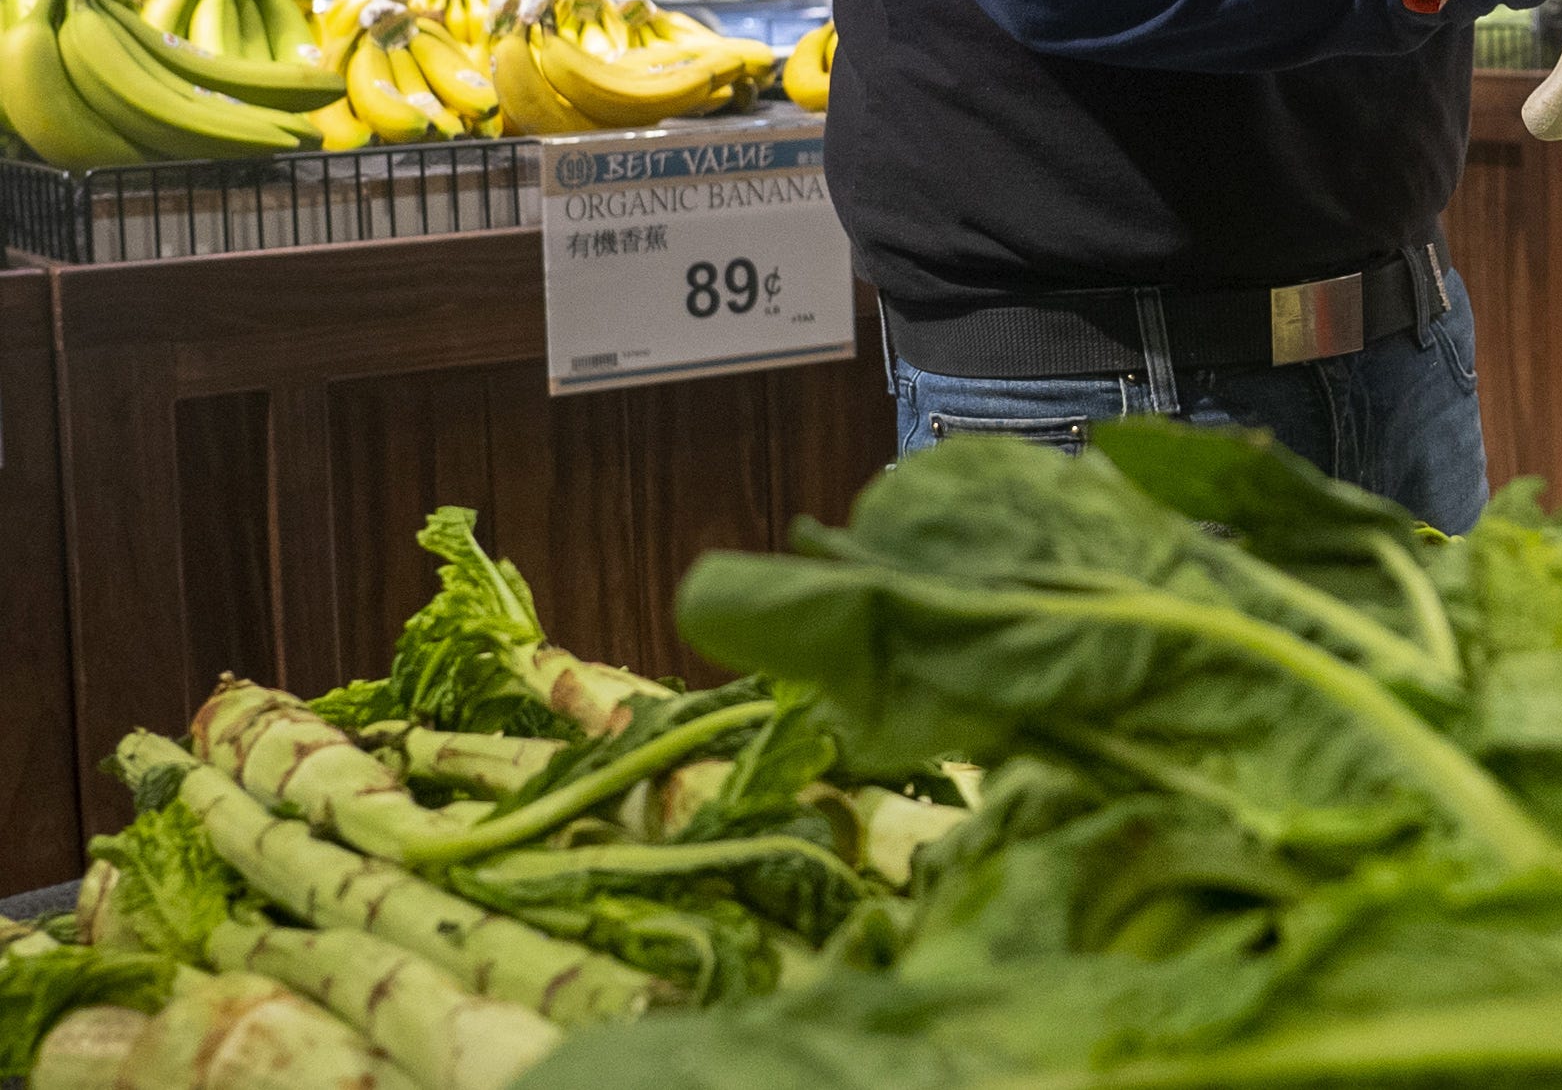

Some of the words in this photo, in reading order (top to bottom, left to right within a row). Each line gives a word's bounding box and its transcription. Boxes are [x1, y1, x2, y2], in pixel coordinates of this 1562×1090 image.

[603, 151, 674, 180] BEST
[682, 142, 775, 177] VALUE
[565, 186, 698, 222] ORGANIC
[708, 175, 825, 210] BANANA
[567, 225, 669, 260] 有機香蕉
